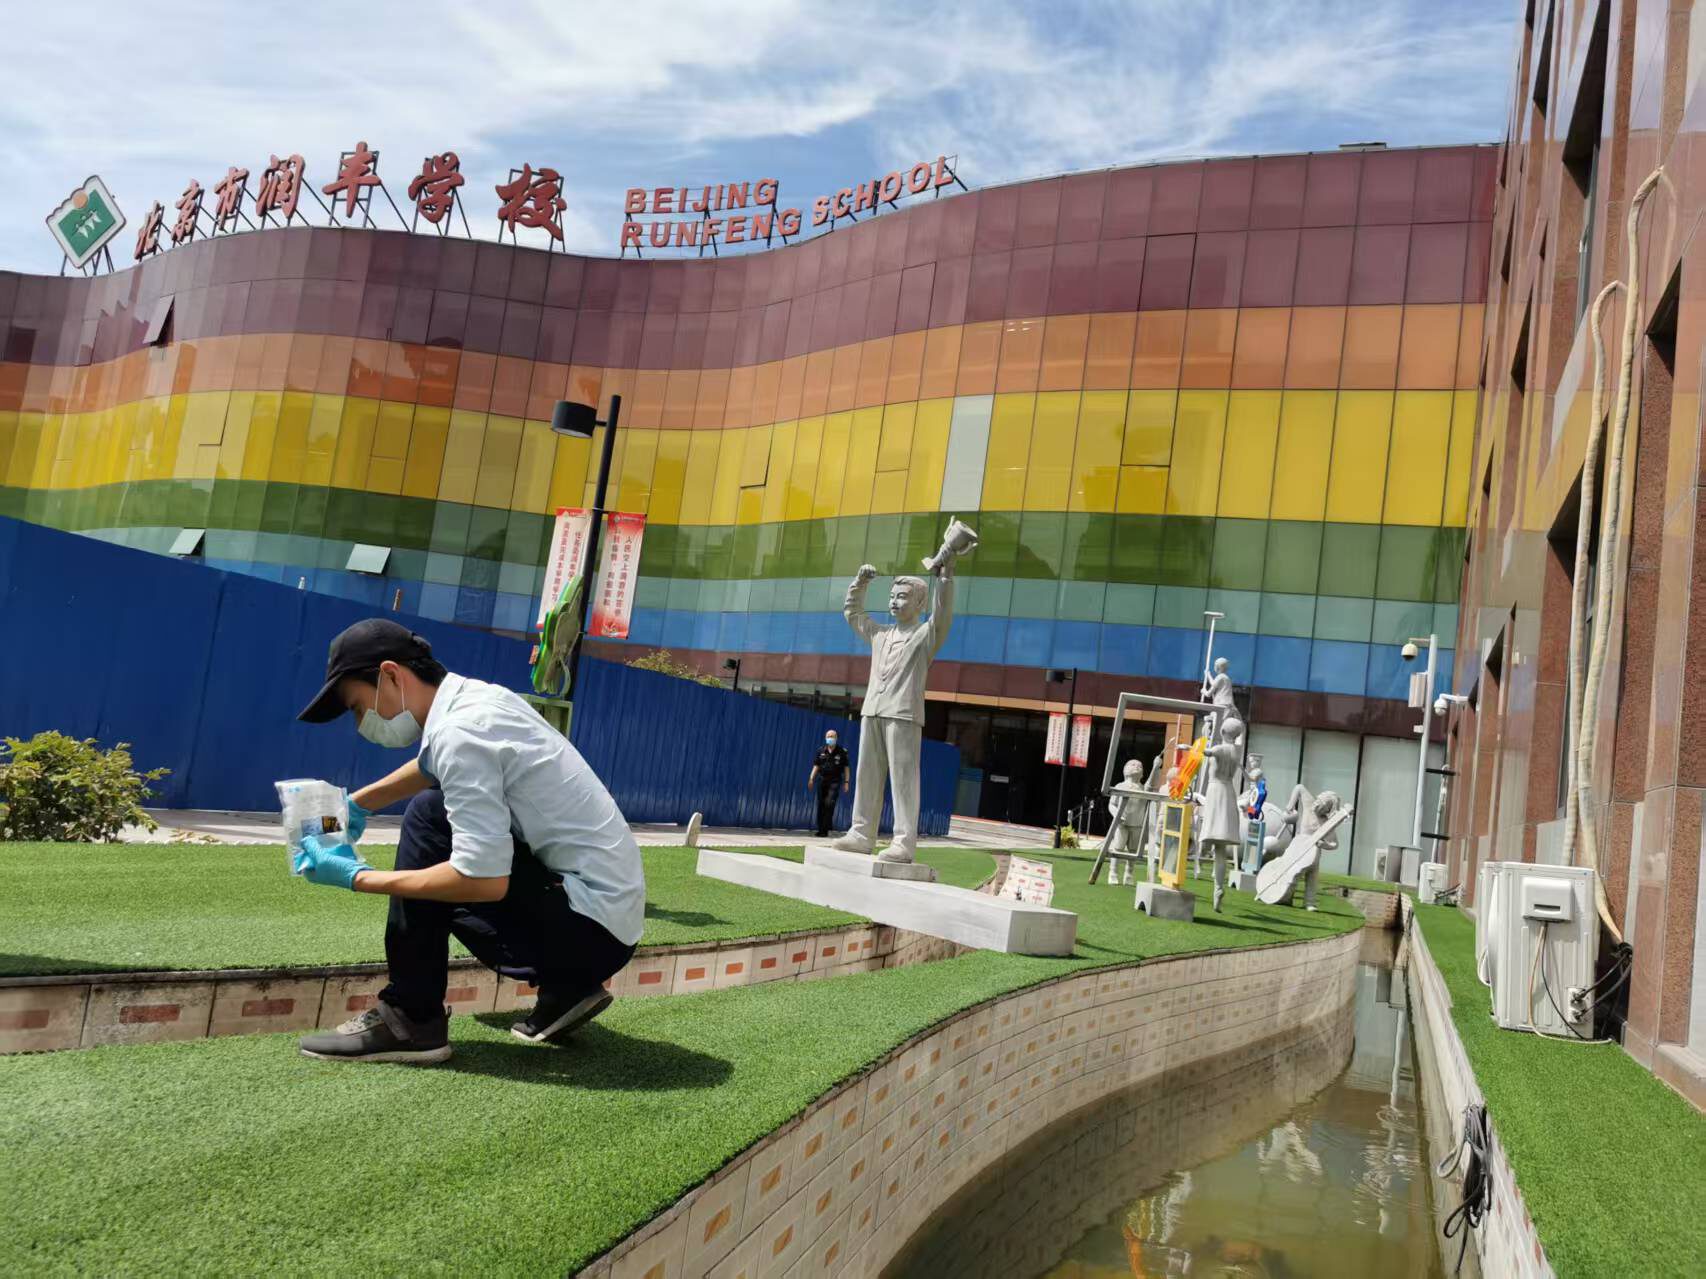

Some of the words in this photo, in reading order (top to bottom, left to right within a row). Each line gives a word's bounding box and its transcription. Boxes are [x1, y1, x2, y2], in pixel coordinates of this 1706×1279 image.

[134, 141, 567, 260] 北京市润丰学校
[621, 207, 801, 248] RUNFENG
[812, 156, 955, 226] SCHOOL
[625, 178, 778, 214] BEIJING
